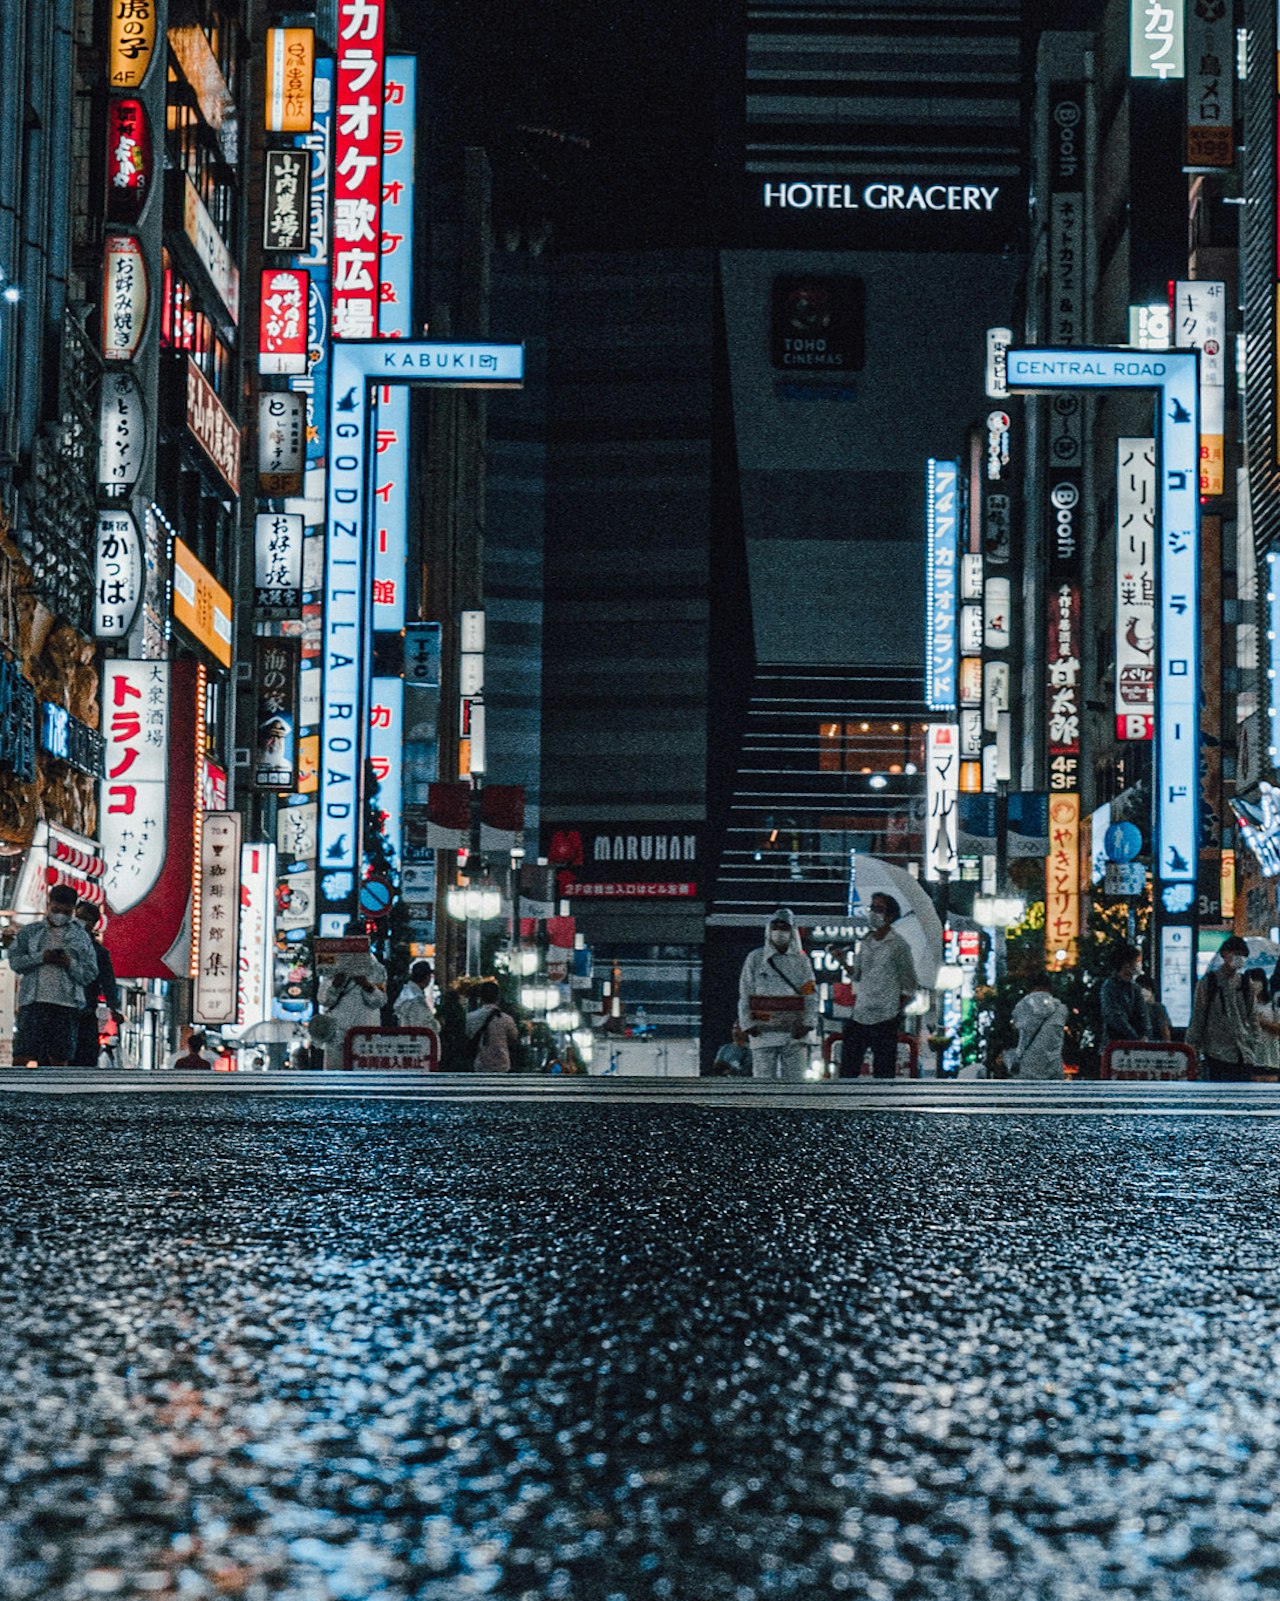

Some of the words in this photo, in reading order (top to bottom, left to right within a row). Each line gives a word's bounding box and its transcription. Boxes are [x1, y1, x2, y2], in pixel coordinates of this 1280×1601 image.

[113, 70, 136, 84] 4F
[763, 183, 861, 209] HOTEL
[863, 183, 1000, 212] GRACERY
[783, 352, 844, 366] CINEMAS
[784, 337, 828, 353] TOHO
[1016, 360, 1107, 377] CENTRAL
[1113, 361, 1167, 378] ROAD
[104, 484, 127, 498] 1F
[934, 472, 957, 538] 747
[101, 520, 129, 532] 新宿
[1050, 481, 1079, 559] Booth
[330, 422, 361, 671] GODZILLA
[99, 533, 129, 606] かっぱ
[101, 614, 124, 629] B1
[932, 546, 956, 699] カラオケランド
[1168, 469, 1193, 804] ゴジラロード
[263, 648, 288, 713] 海の家
[144, 664, 165, 748] 大衆酒場
[108, 674, 142, 816] トラノコ
[326, 703, 354, 820] ROAD
[1051, 759, 1078, 773] 4F
[1051, 774, 1078, 790] 3F
[593, 835, 697, 862] MARUHAN
